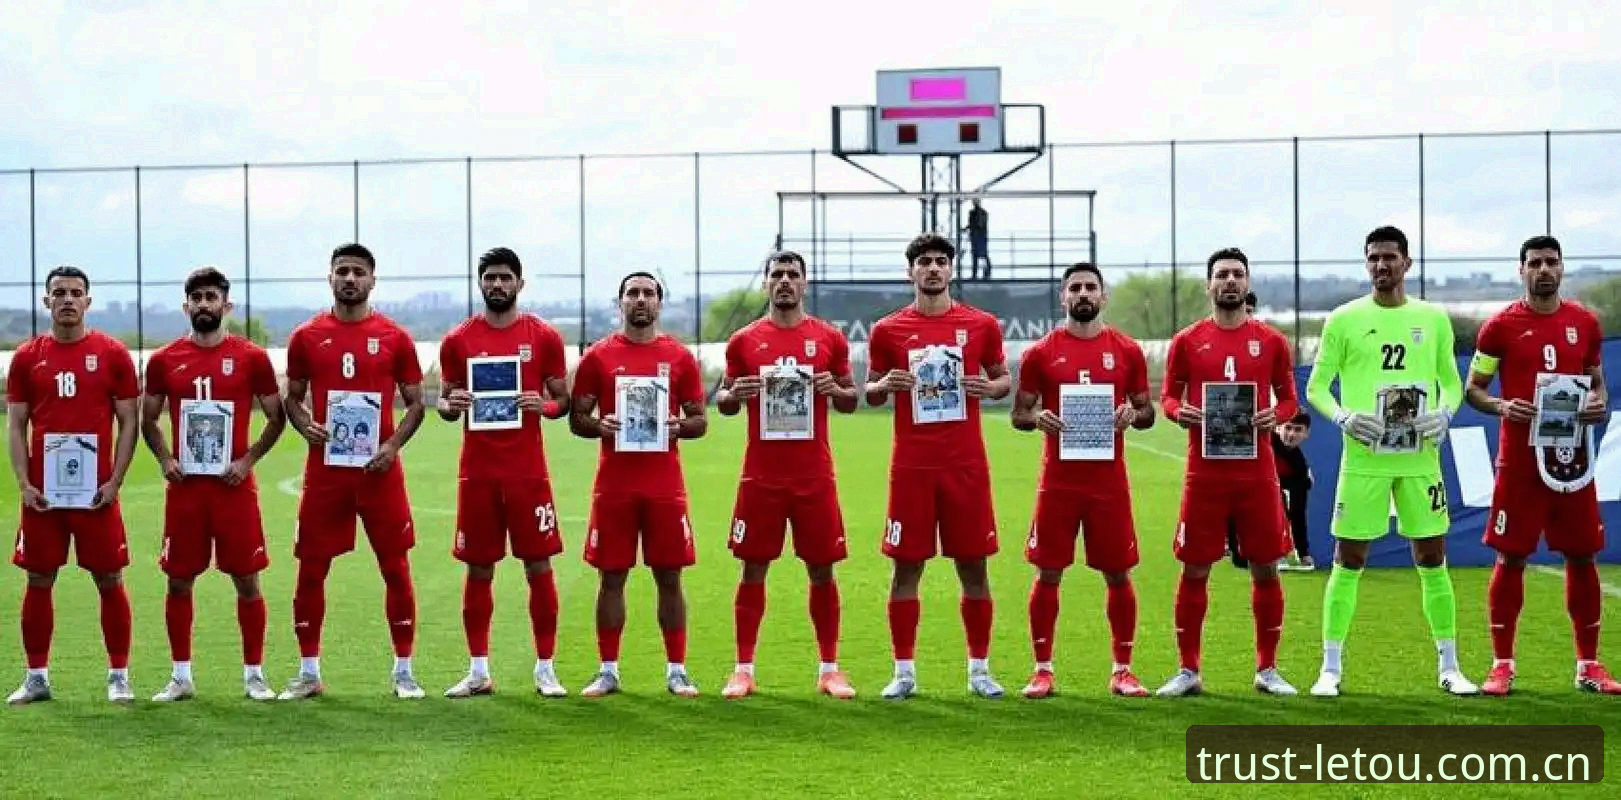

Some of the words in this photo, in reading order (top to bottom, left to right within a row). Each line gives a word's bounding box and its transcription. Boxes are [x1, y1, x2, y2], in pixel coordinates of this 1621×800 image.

[342, 352, 355, 379] 8
[1224, 355, 1236, 382] 4
[1381, 344, 1406, 370] 22
[1543, 344, 1557, 371] 9
[55, 371, 76, 397] 18
[192, 376, 212, 401] 11
[1494, 510, 1507, 536] 9
